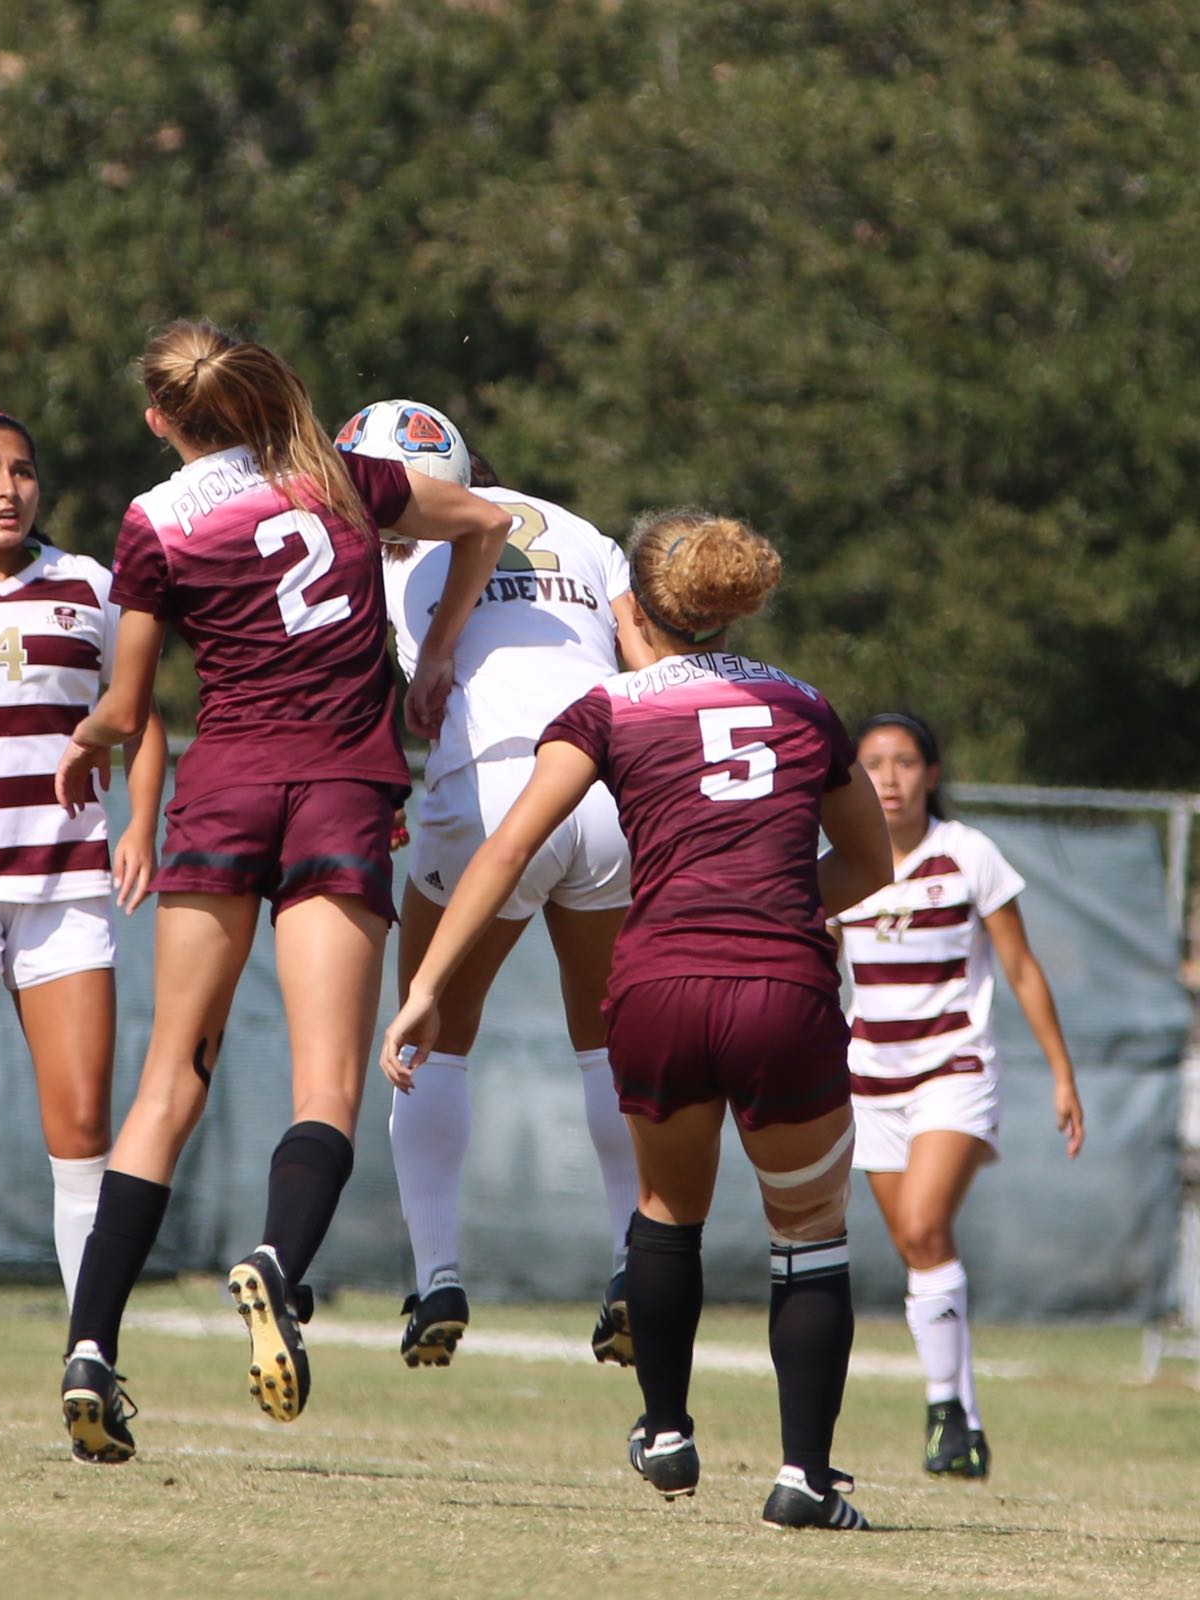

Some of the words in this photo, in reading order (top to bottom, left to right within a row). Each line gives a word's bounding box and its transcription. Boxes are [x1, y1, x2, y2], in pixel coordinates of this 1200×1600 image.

[253, 509, 352, 637] 2
[697, 705, 777, 801] 5
[875, 907, 913, 943] 27
